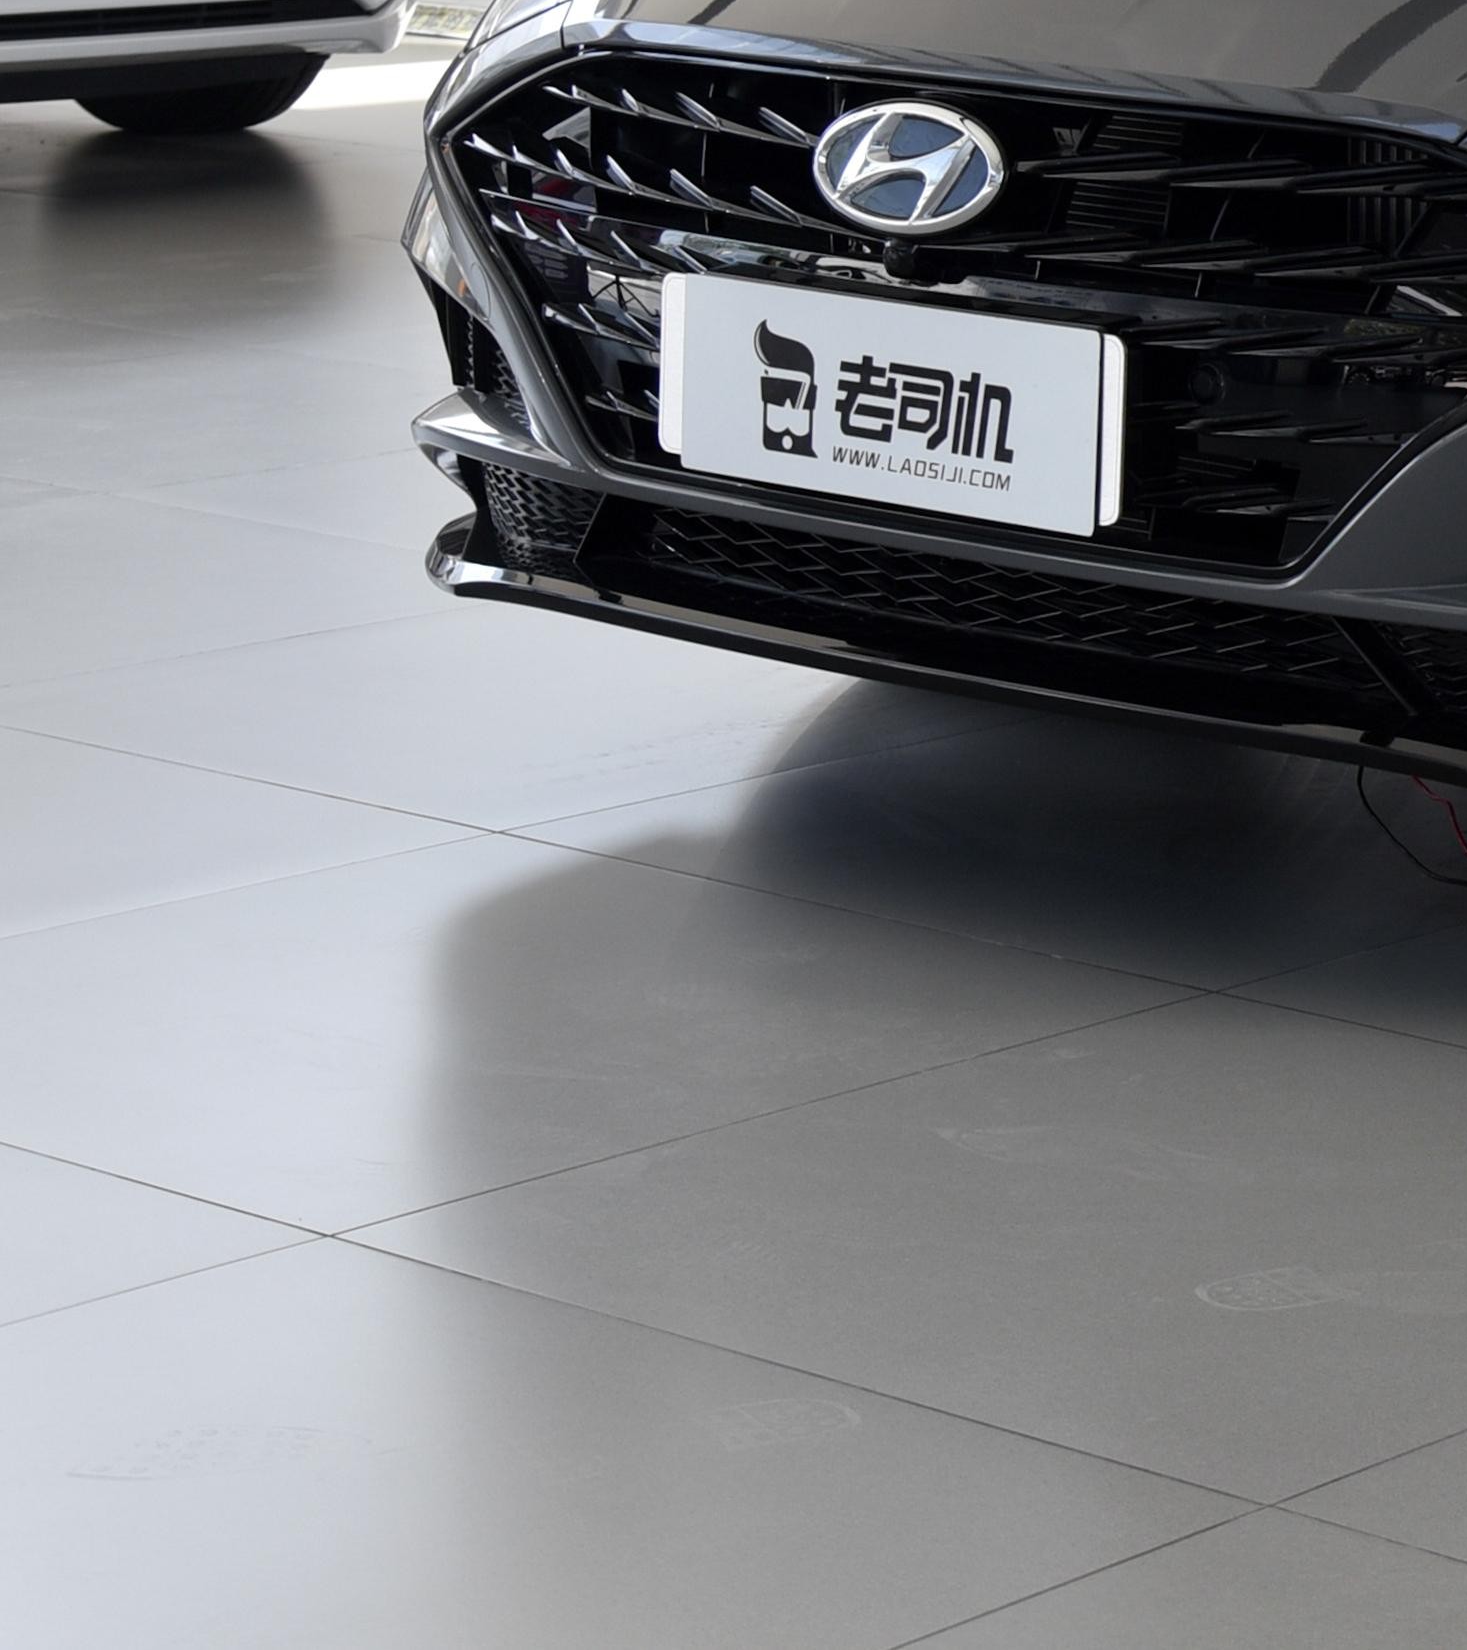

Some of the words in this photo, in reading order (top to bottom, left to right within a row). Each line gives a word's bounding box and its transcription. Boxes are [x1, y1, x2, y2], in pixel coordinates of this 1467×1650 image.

[834, 354, 1014, 464] 老司机
[831, 445, 1013, 493] WWW.LAOSIJI.COM
